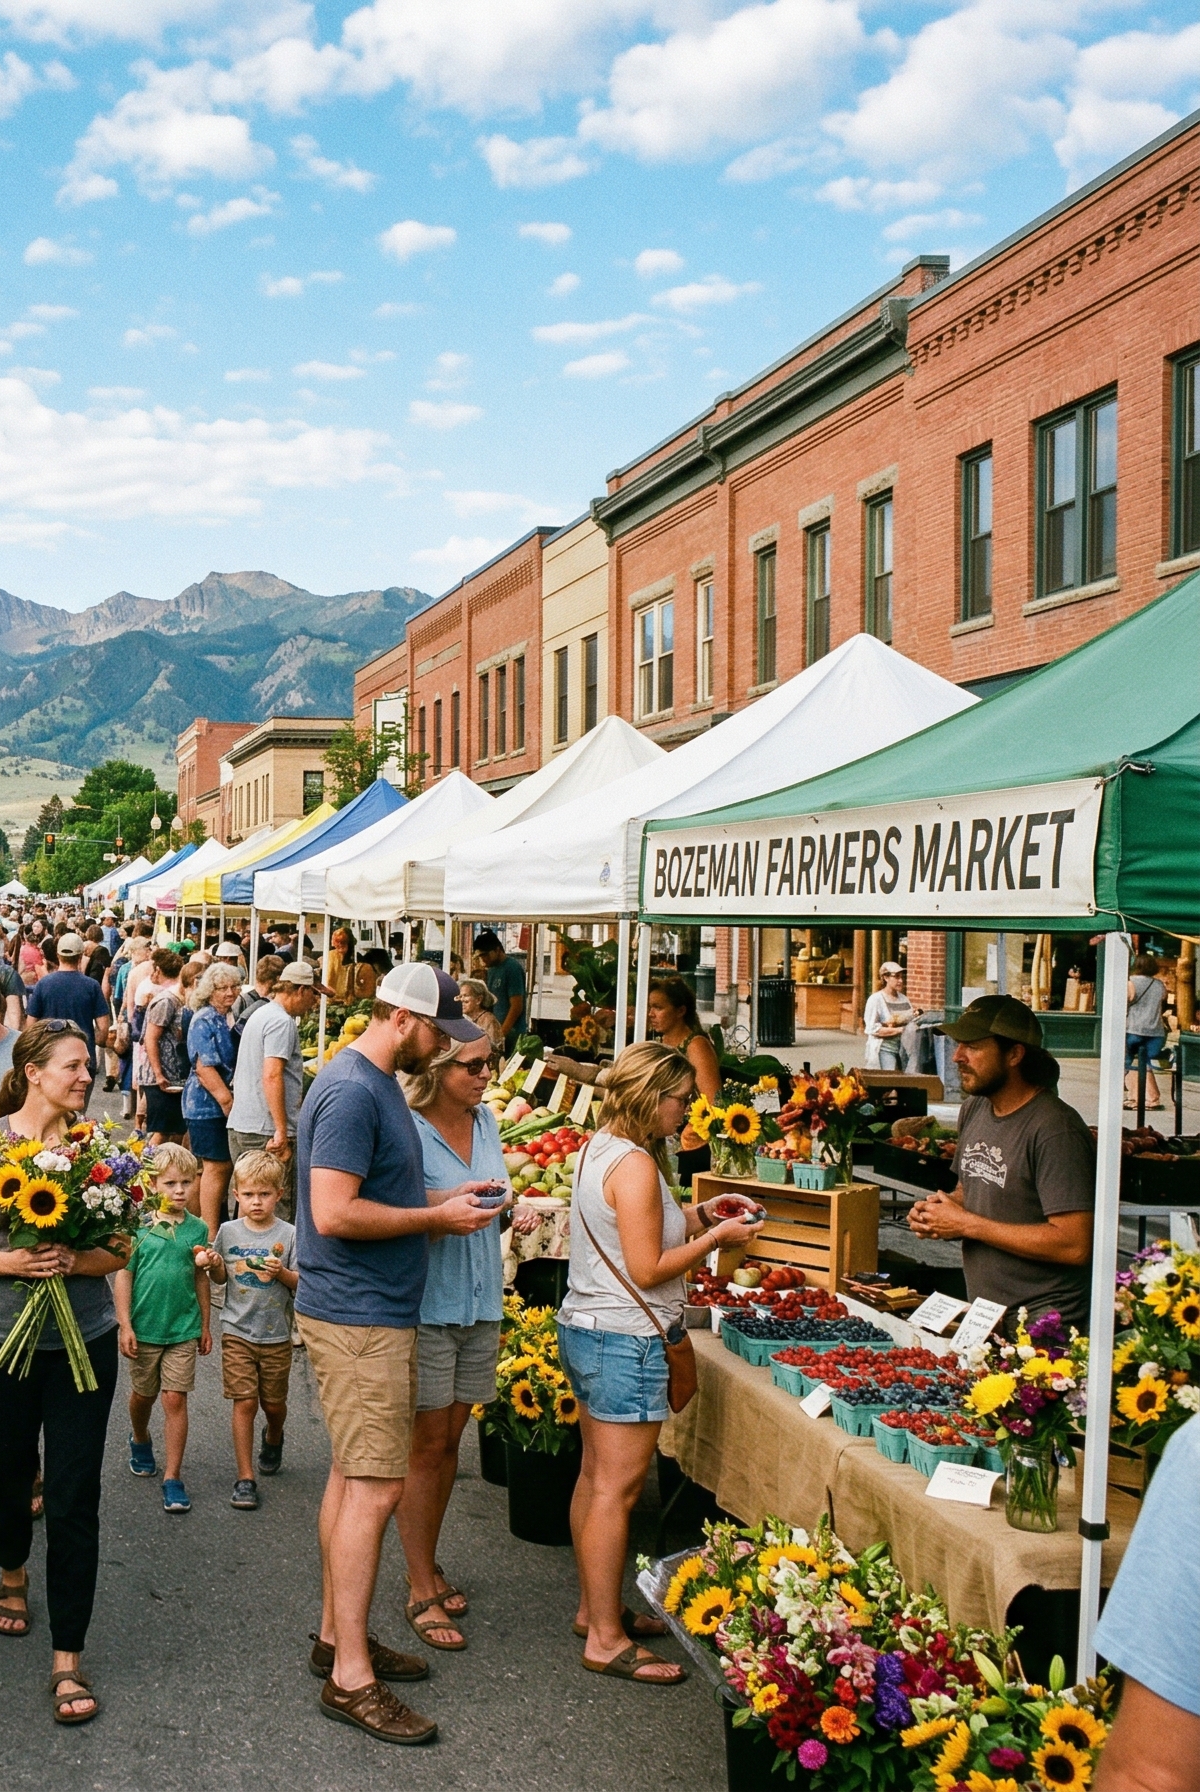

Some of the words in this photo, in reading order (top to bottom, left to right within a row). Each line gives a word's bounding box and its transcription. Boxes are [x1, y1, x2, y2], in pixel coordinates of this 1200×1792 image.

[653, 840, 760, 898] BOZEMAN
[763, 825, 902, 897] FARMERS
[908, 808, 1076, 894] MARKET
